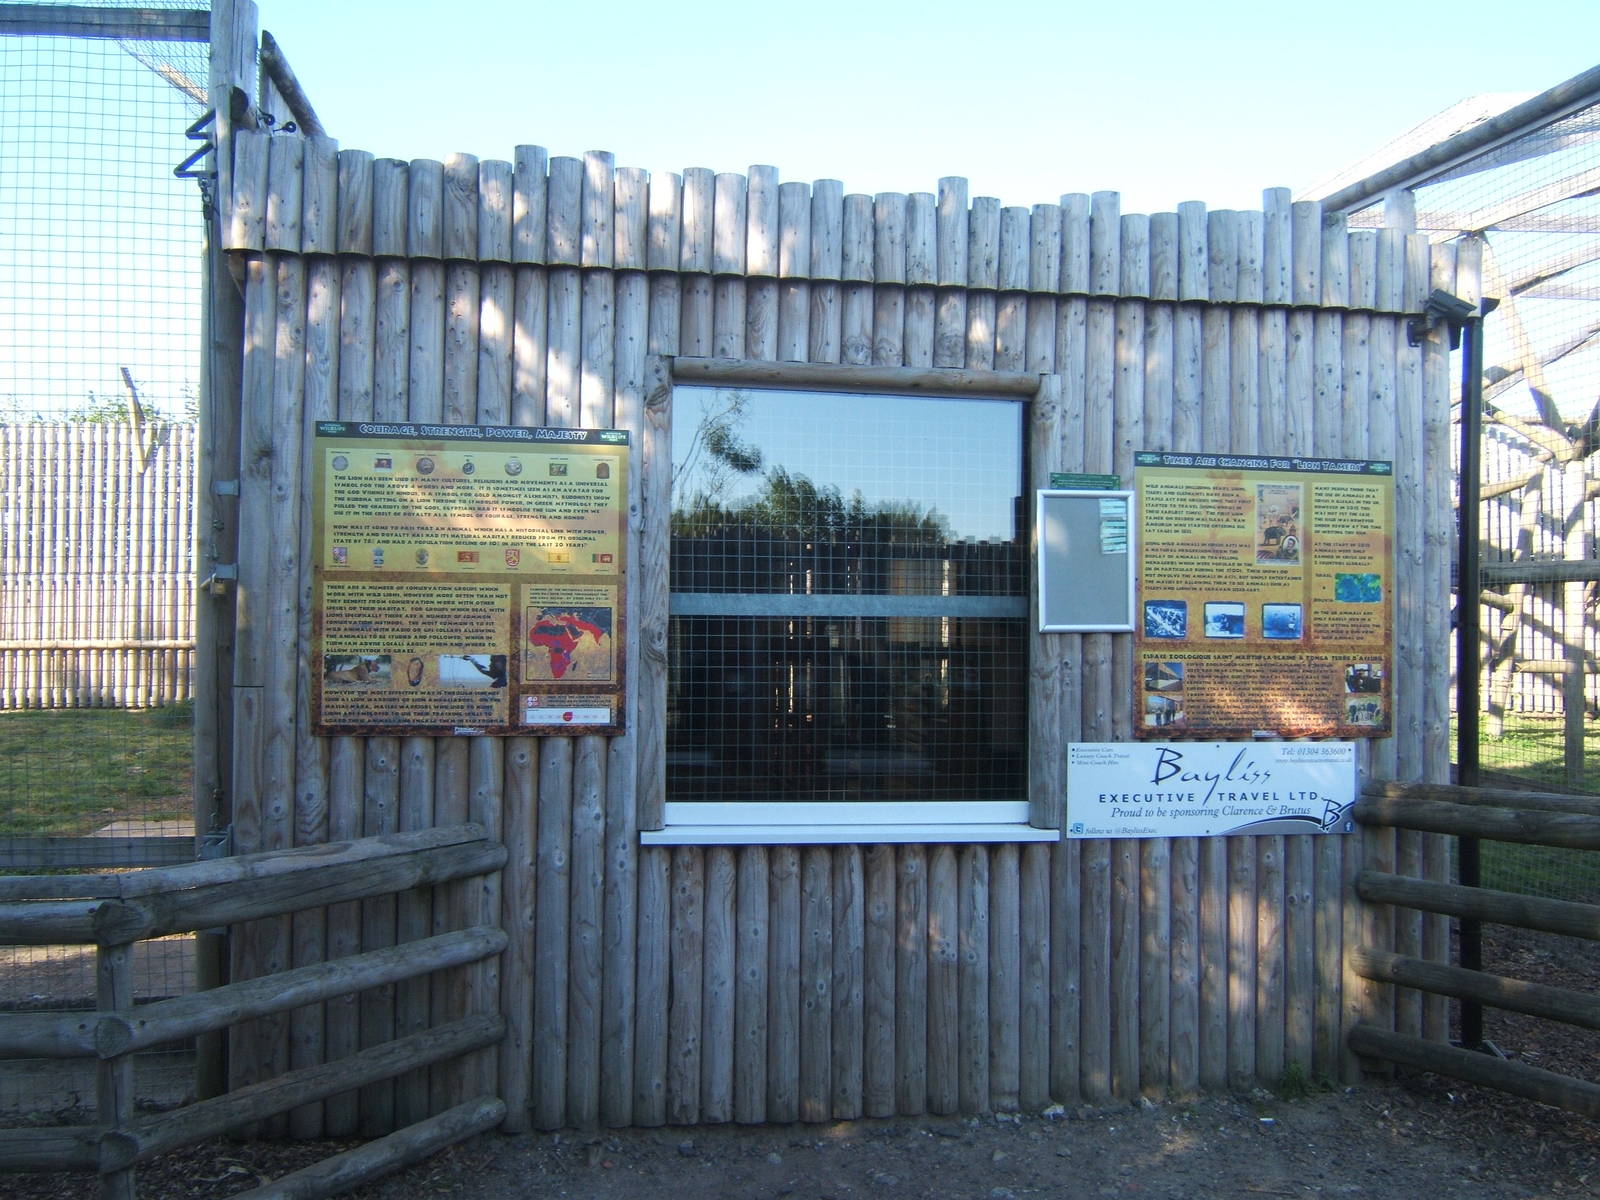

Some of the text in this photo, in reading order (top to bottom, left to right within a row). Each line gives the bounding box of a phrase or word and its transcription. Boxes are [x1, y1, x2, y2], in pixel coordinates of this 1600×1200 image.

[359, 424, 587, 440] COURAGE, STRENGTH, POWER, MAJESTY
[1195, 456, 1216, 466] ARE
[1219, 457, 1268, 468] CHANGING
[1270, 459, 1290, 469] FOR
[1150, 748, 1271, 806] Bayliss
[1099, 792, 1318, 803] EXECUTIVE TRAVEL LTD
[1111, 805, 1311, 819] Proud to be sponsoring Clarence & Brutus
